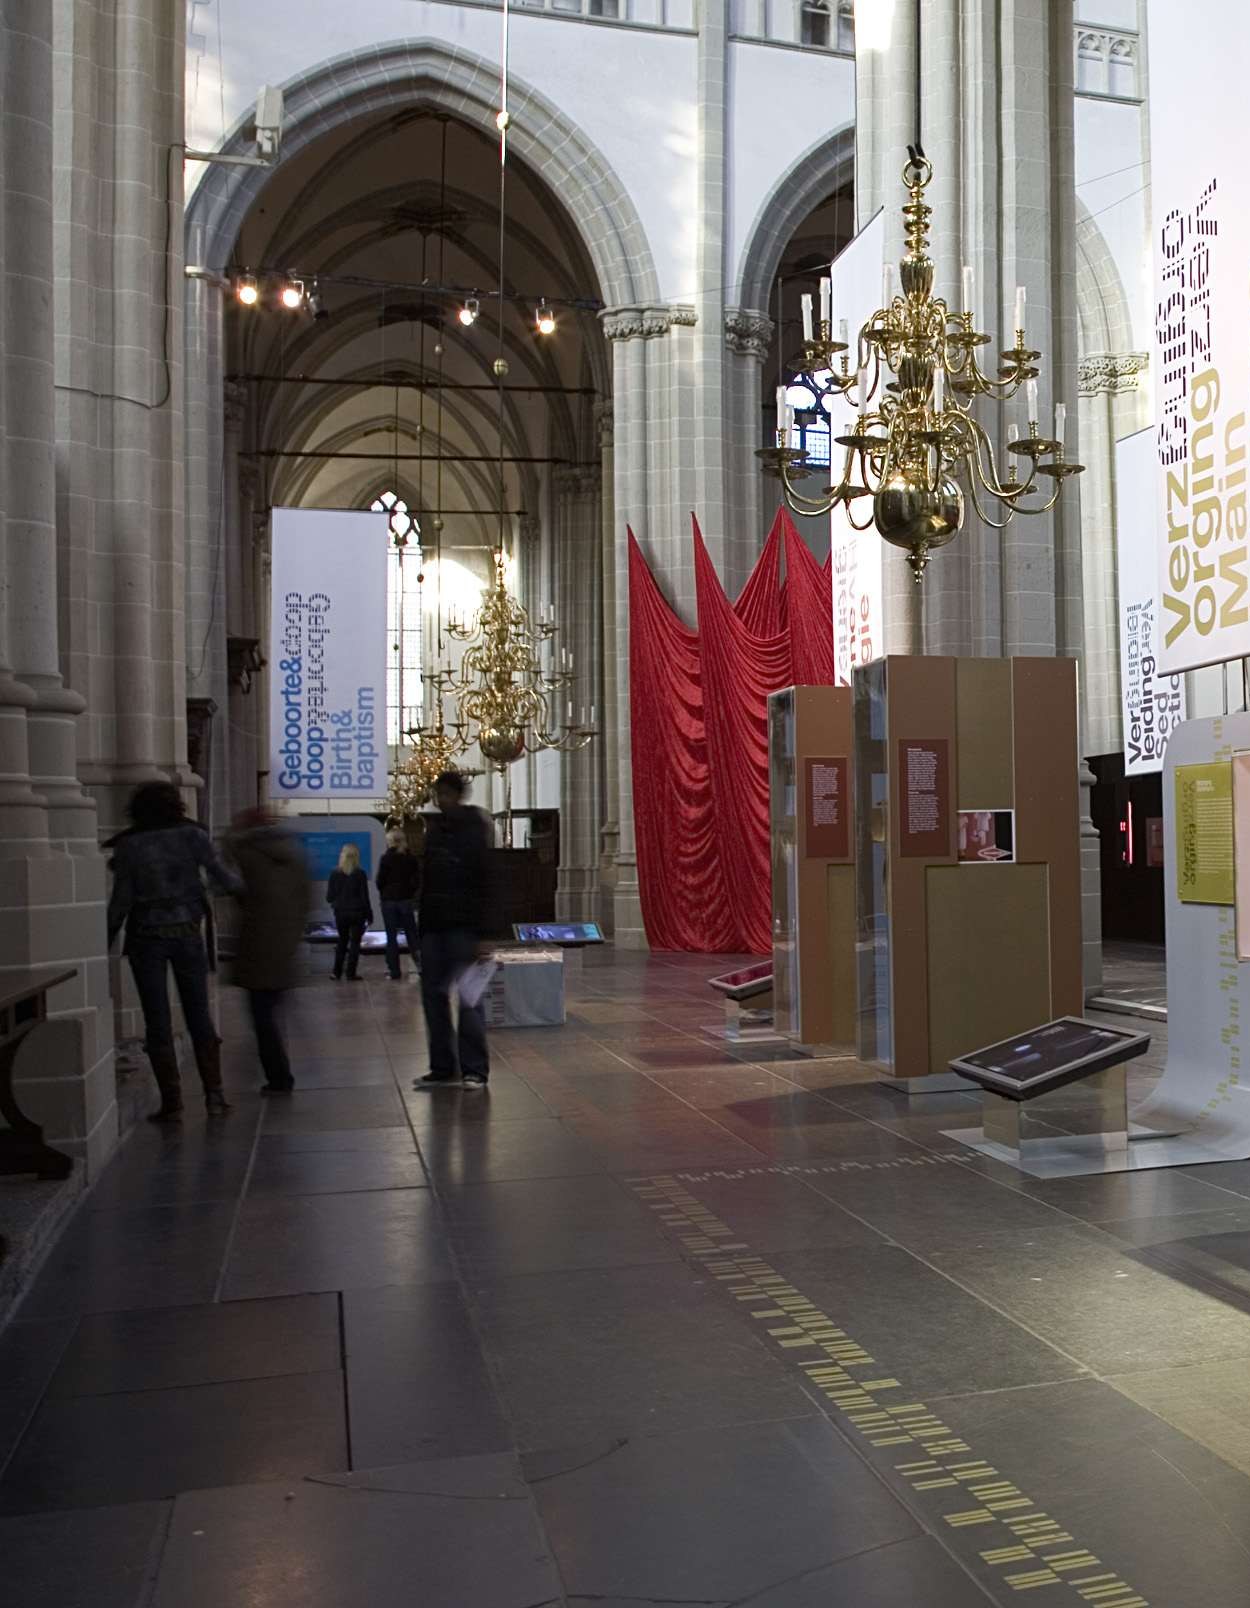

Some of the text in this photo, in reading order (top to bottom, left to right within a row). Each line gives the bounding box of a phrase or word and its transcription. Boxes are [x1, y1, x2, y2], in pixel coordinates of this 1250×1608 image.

[1190, 368, 1221, 636] orging
[1218, 411, 1249, 628] Main
[1162, 465, 1191, 649] Verz
[278, 656, 303, 790] Geboorte&
[330, 709, 353, 790] Birth&
[353, 687, 379, 790] baptism
[1128, 710, 1142, 765] Ver
[1140, 655, 1155, 761] leiding
[1154, 692, 1168, 759] Sed
[1168, 674, 1181, 731] ctio
[302, 726, 328, 790] doop
